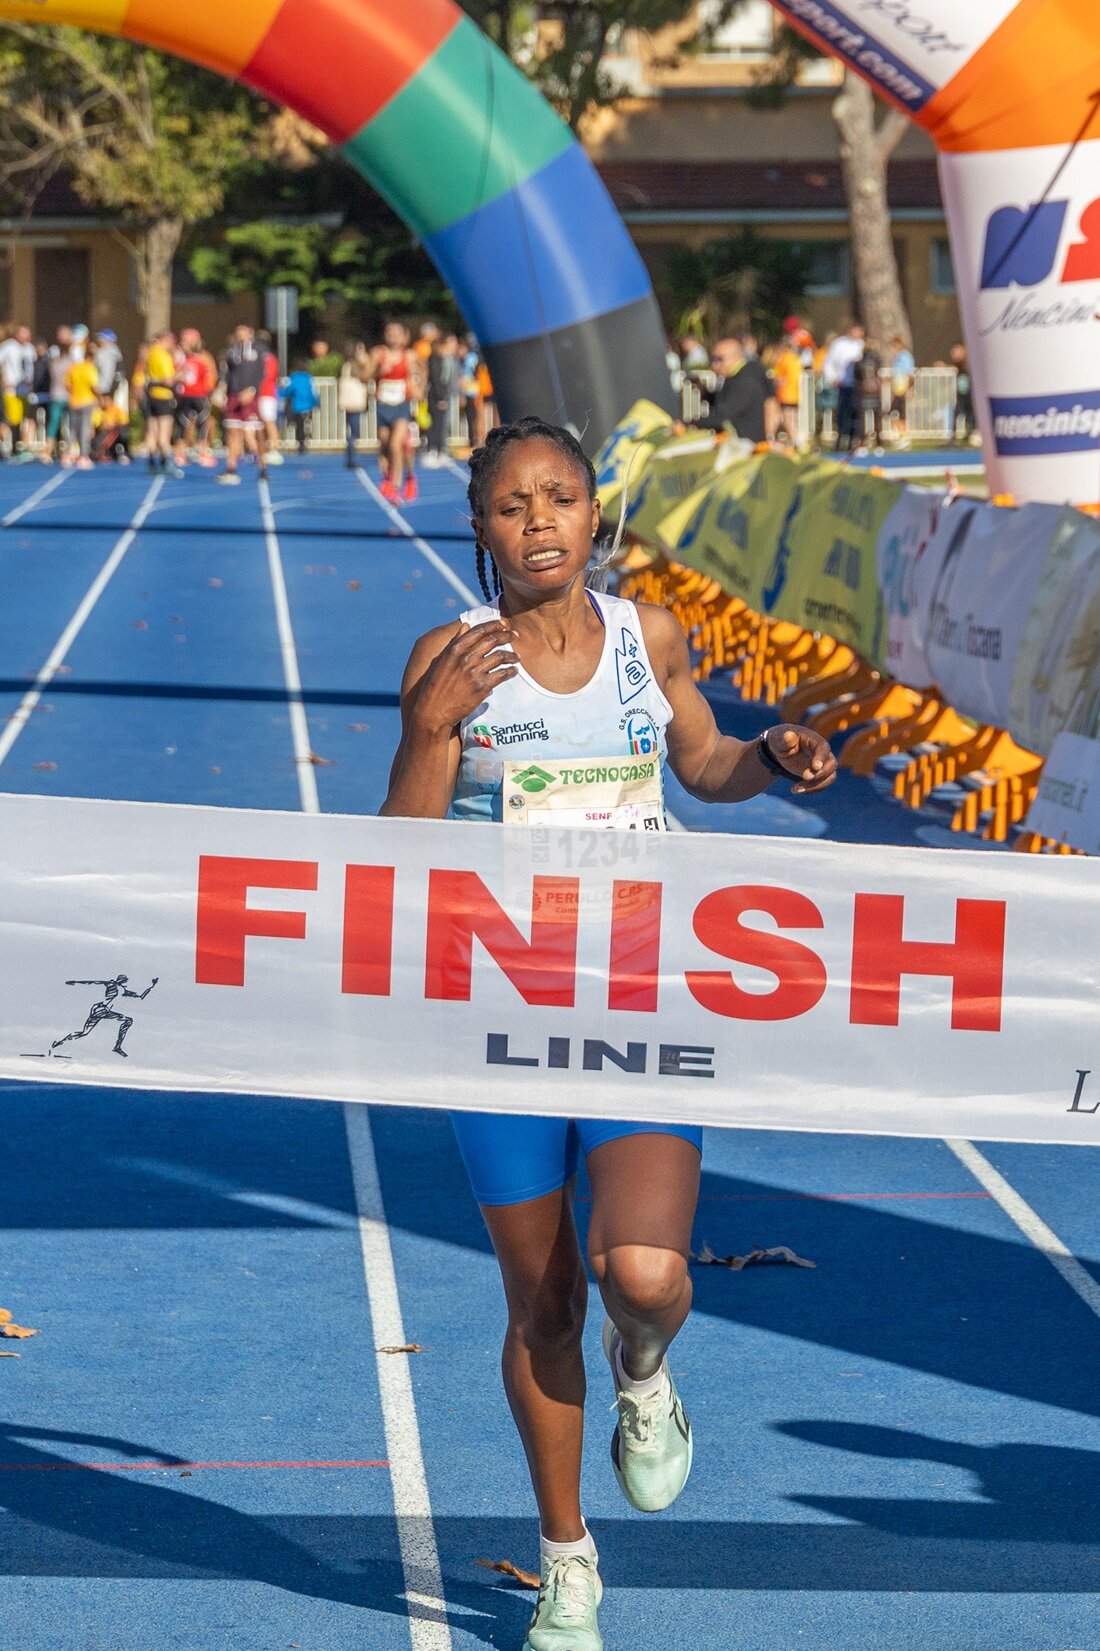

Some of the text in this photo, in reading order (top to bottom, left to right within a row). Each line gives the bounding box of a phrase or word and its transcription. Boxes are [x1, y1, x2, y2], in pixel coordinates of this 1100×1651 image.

[490, 718, 545, 736] Santucci
[496, 729, 550, 746] Running
[559, 763, 656, 785] TECNOCASA
[585, 812, 613, 821] SENF
[558, 825, 640, 868] 1234
[196, 855, 1006, 1032] FINISH
[486, 1033, 715, 1078] LINE
